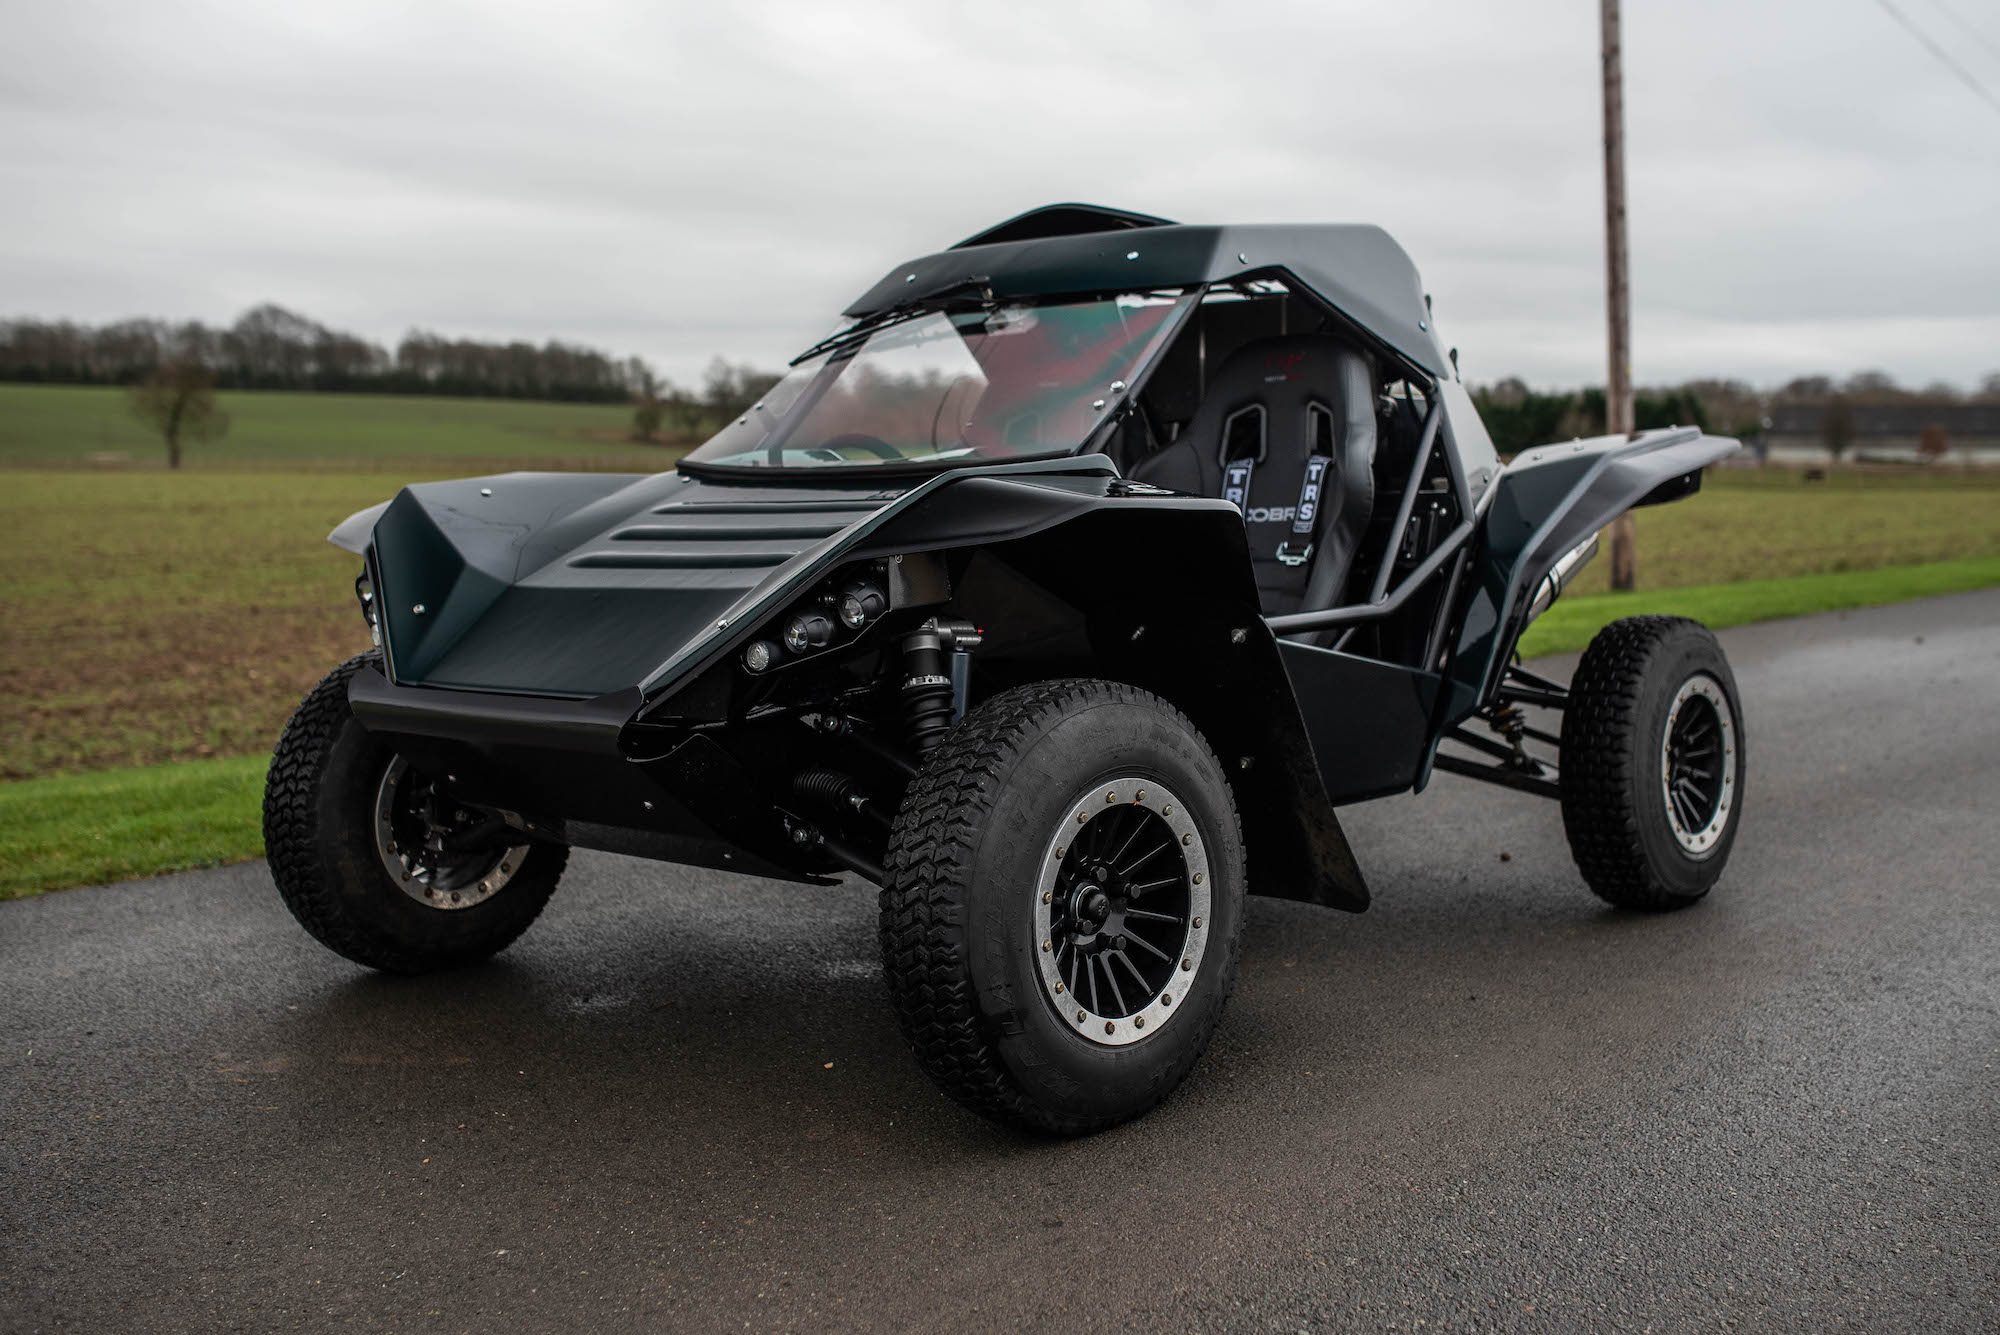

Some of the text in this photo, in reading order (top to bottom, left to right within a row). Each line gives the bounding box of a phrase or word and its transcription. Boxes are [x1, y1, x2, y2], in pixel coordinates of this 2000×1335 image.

[1225, 468, 1247, 504] TR
[1299, 464, 1322, 520] TRS
[1247, 506, 1296, 522] OBR
